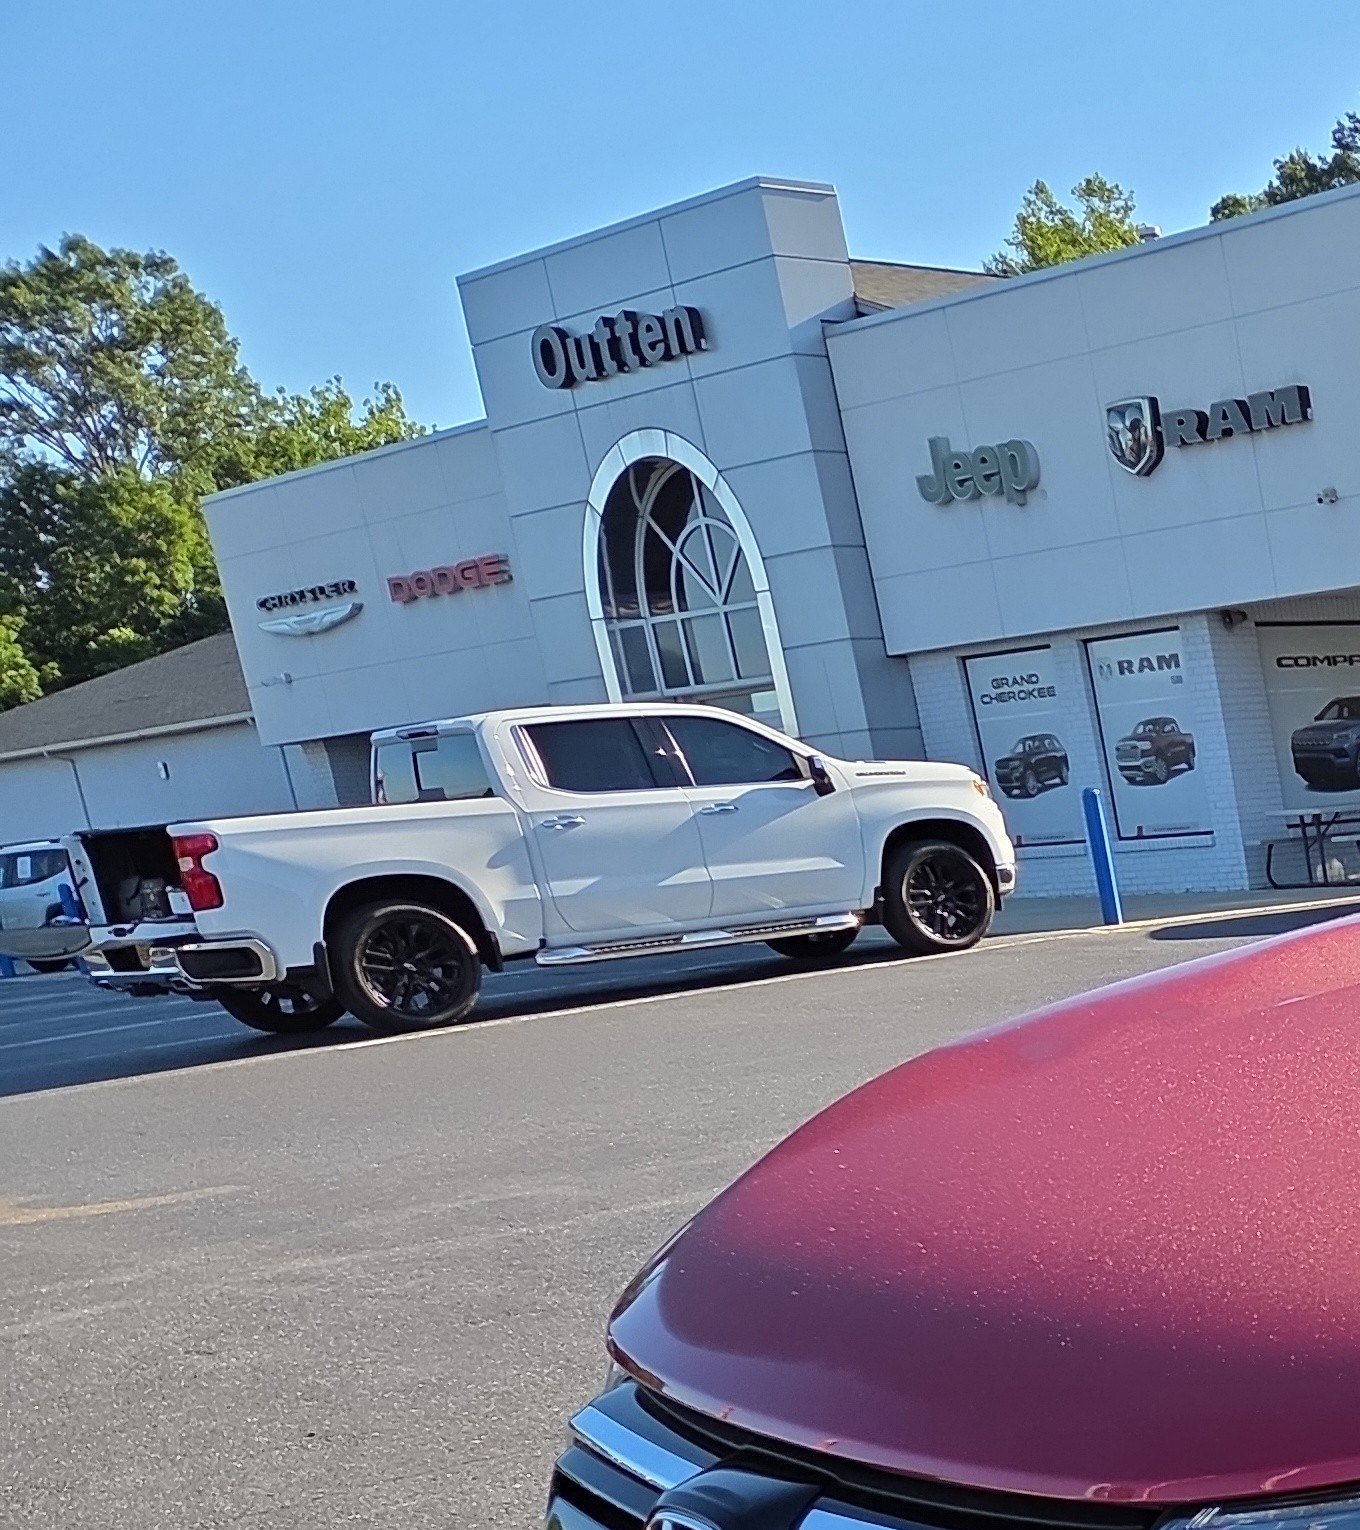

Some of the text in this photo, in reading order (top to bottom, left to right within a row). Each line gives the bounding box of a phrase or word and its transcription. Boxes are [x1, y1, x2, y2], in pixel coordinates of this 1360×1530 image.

[531, 304, 707, 390] Outten
[1161, 384, 1313, 448] RAM
[915, 435, 1041, 506] Jeep
[256, 579, 358, 612] CHRYSLER
[386, 553, 513, 604] DODGE
[991, 673, 1040, 690] GRAND
[1117, 653, 1181, 676] RAM
[980, 686, 1056, 705] CHEROKEE
